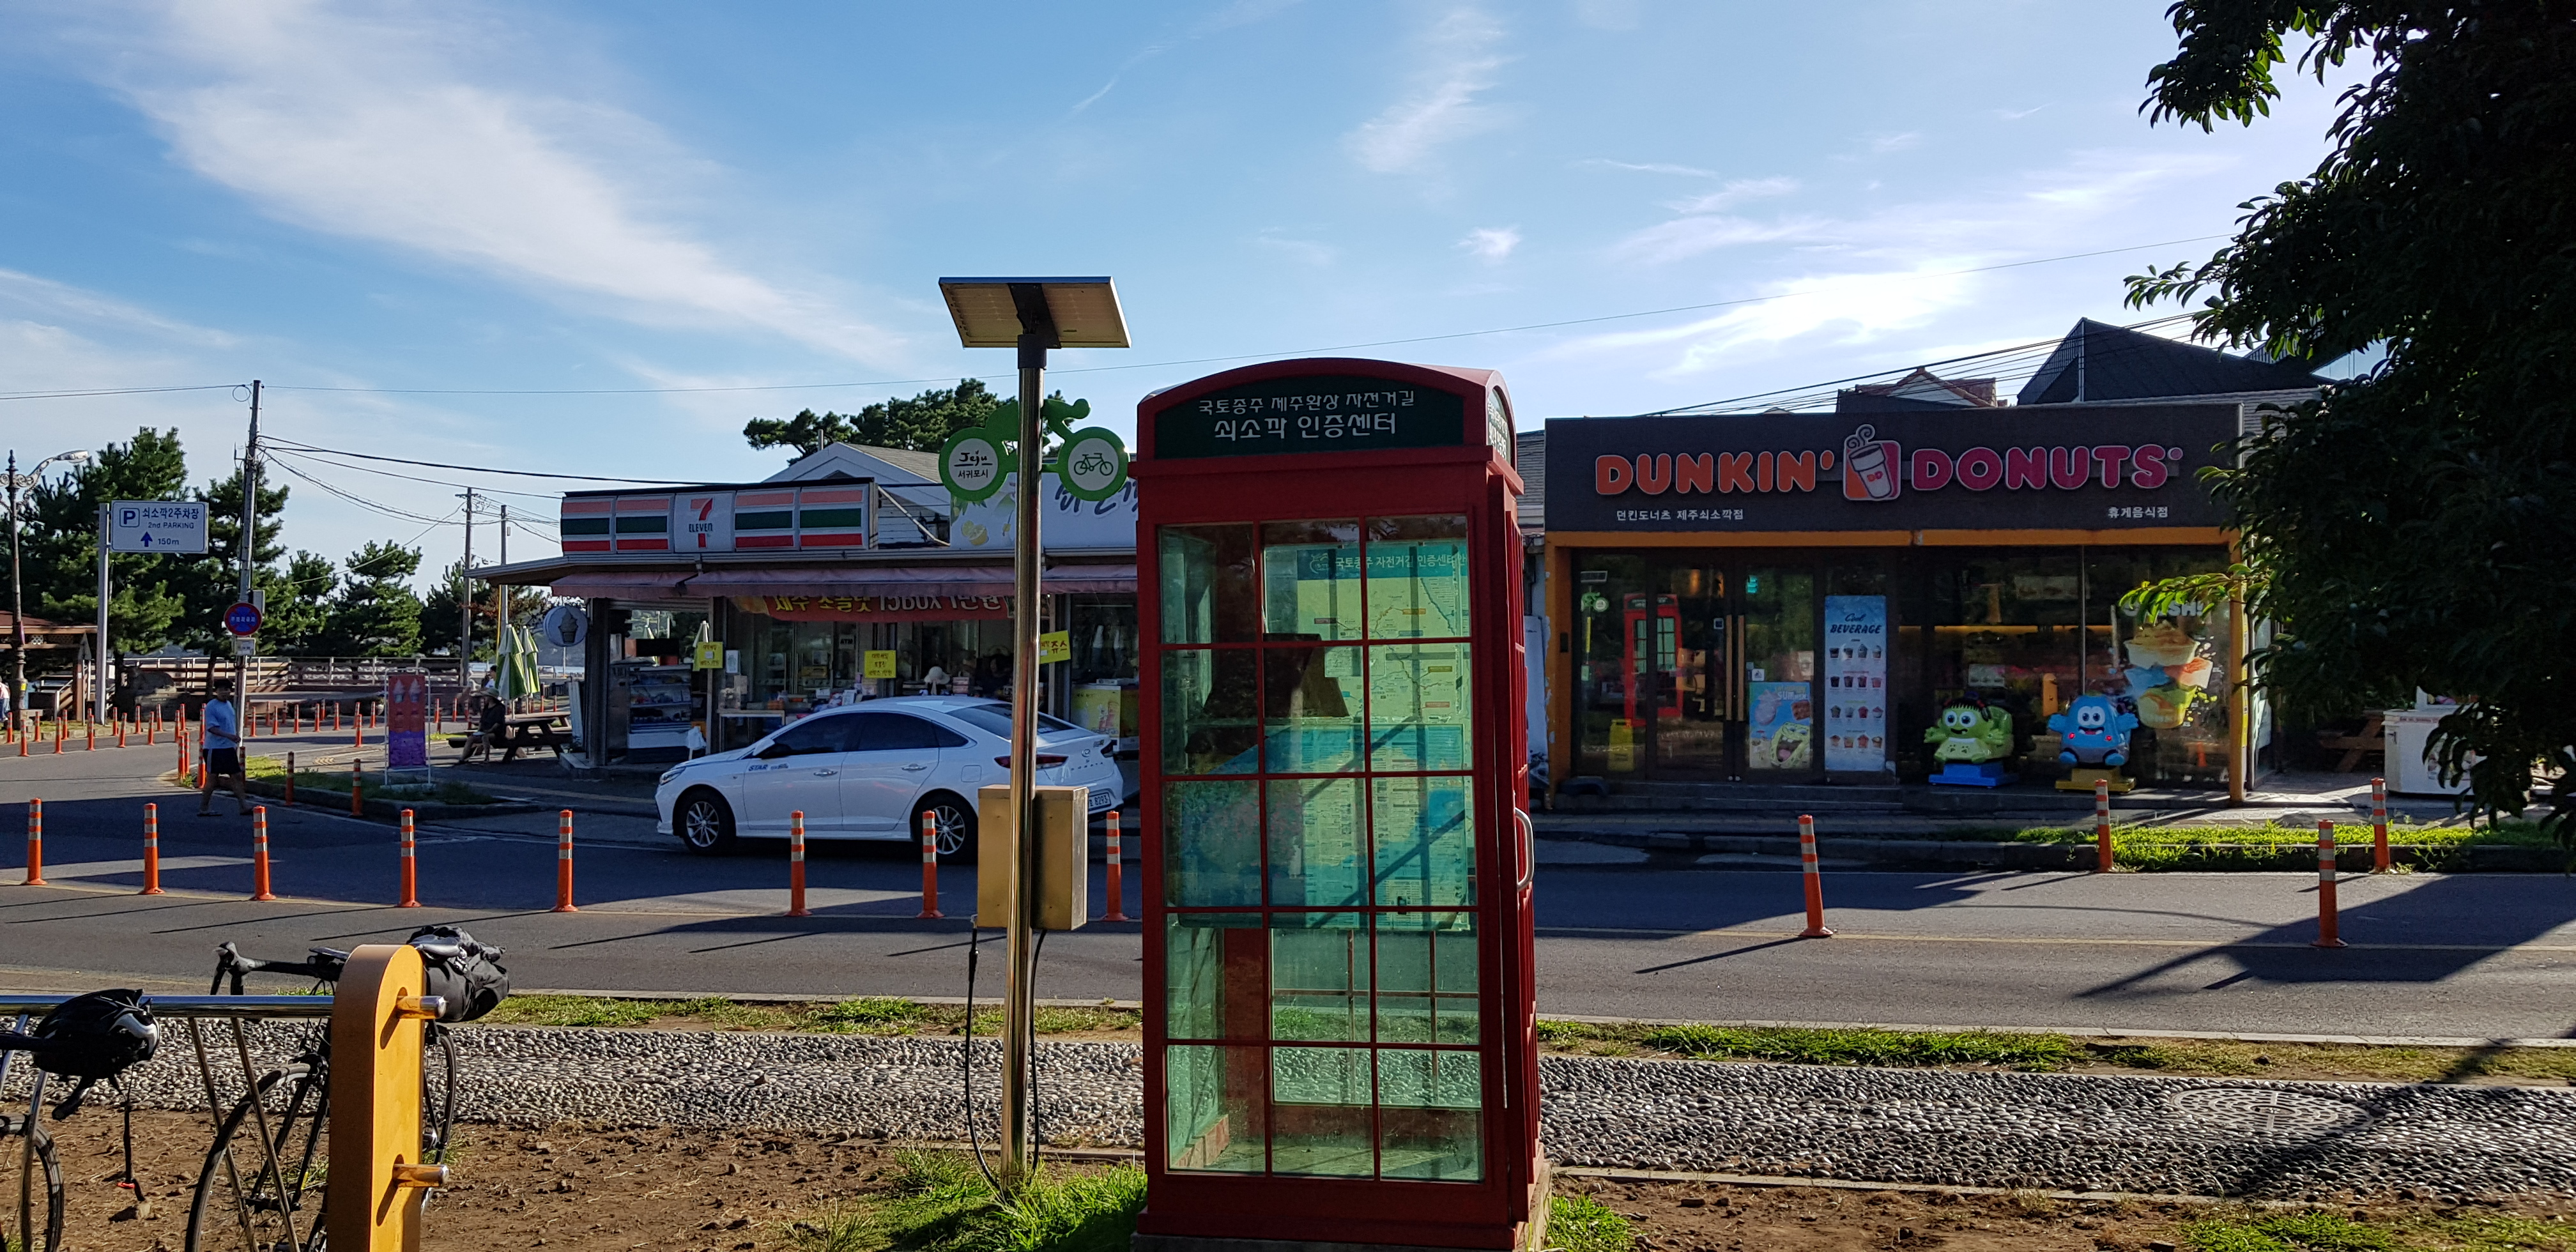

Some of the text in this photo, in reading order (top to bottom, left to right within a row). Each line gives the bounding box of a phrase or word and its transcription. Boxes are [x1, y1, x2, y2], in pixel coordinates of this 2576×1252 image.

[1199, 390, 1414, 415] 국토종주 제주환상 자전거길
[1214, 413, 1396, 441] 쇠소깍 인증센터
[959, 450, 988, 466] Jeju
[958, 468, 988, 479] 서귀포시
[1595, 444, 2168, 495] DUNKIN' DONUTS
[123, 510, 136, 524] P
[142, 507, 199, 520] 쇠소깍2주차장
[1616, 509, 1744, 521] 던킨도너츠 제주쇠소깍점
[2108, 506, 2169, 519] 휴게음식점
[1376, 555, 1414, 568] 자전거길
[1830, 624, 1882, 634] BEVERAGE
